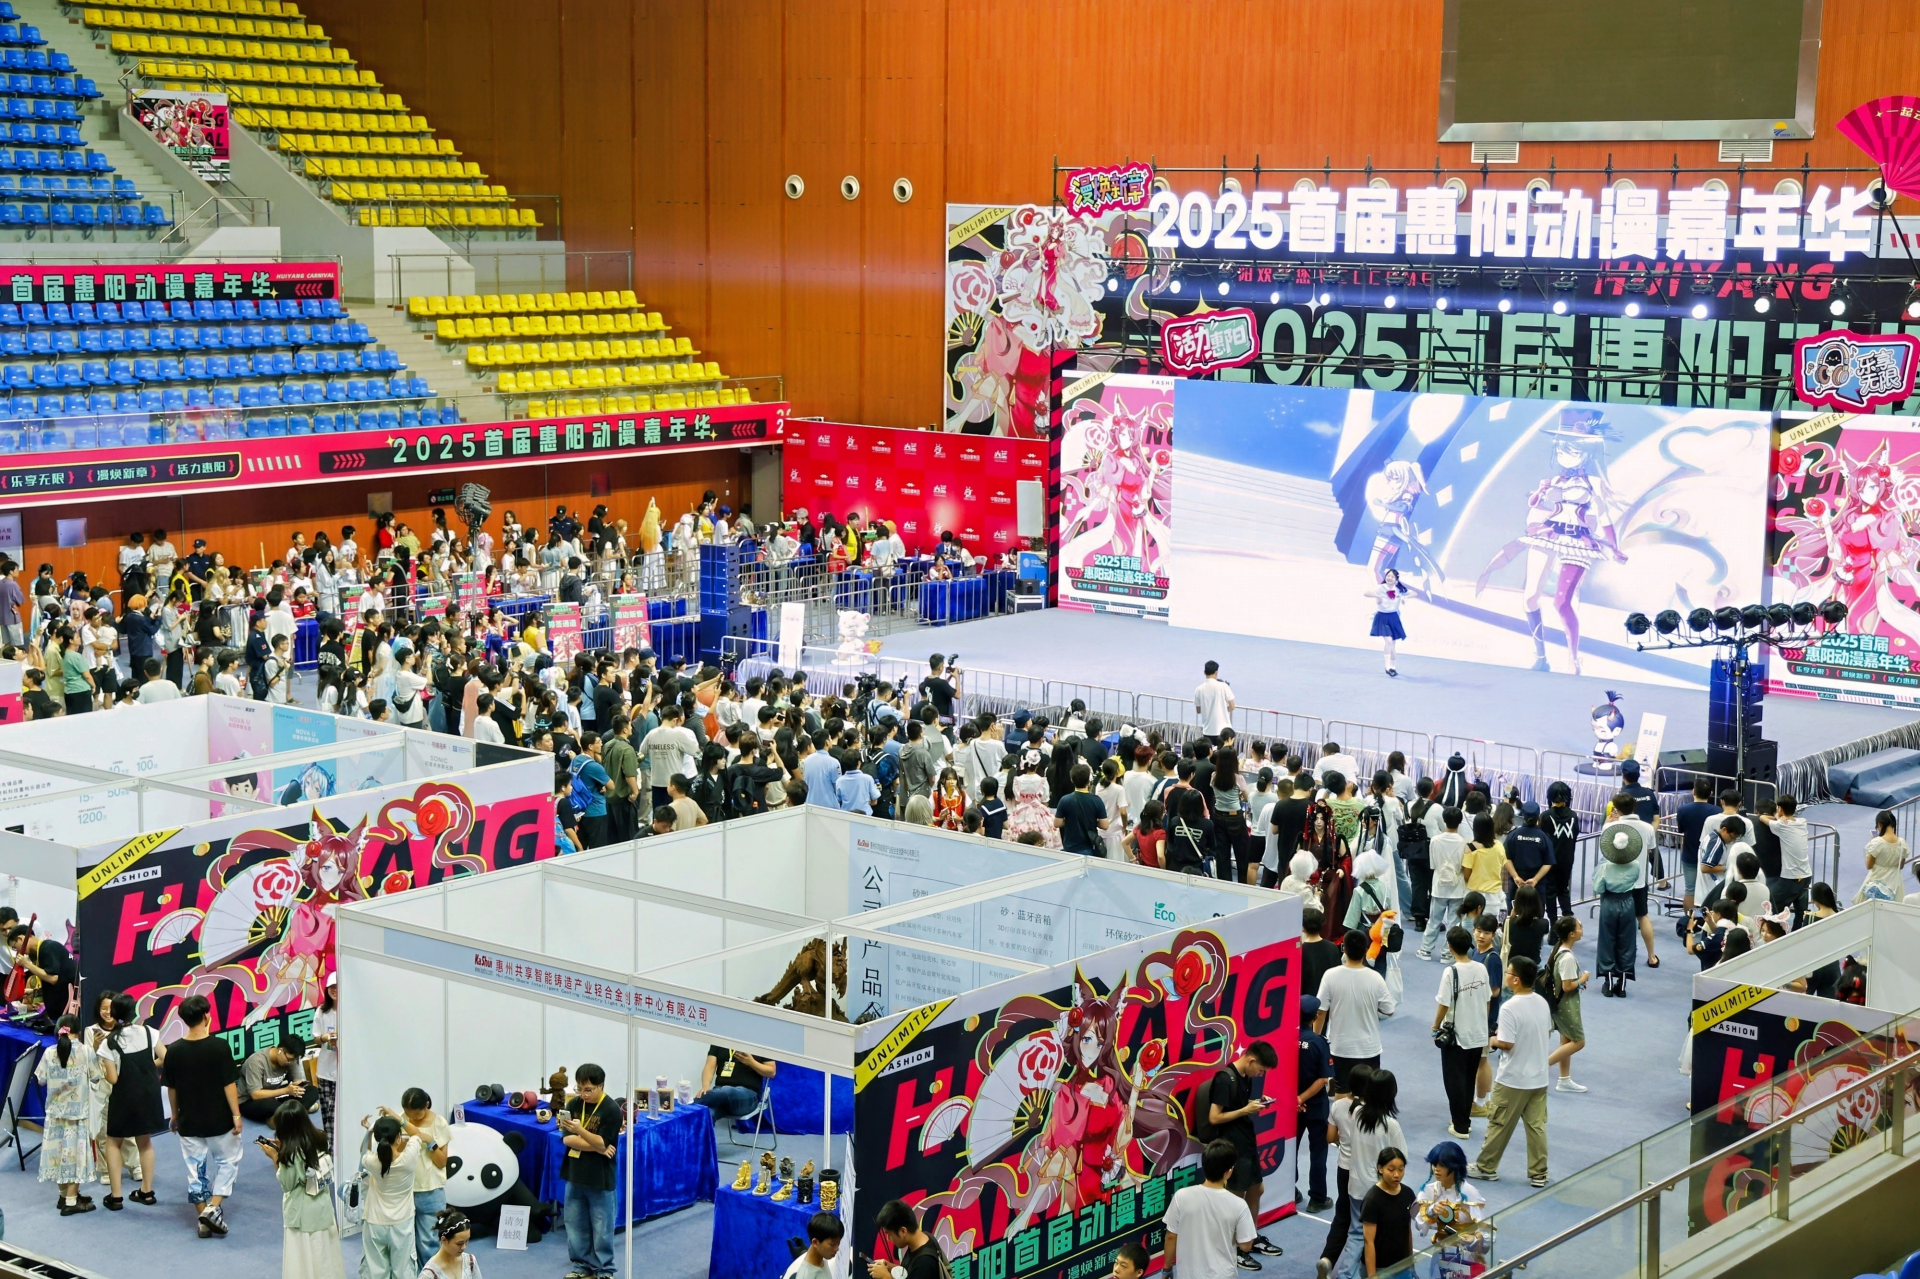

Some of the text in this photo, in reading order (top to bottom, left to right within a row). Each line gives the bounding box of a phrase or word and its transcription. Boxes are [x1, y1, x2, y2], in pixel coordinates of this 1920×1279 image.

[1073, 169, 1147, 209] 漫焕新章
[957, 208, 1005, 238] UNLIMITED
[1148, 184, 1873, 264] 2025首届惠阳动漫嘉年华
[11, 271, 271, 301] 首届惠阳动漫嘉年华
[1173, 320, 1248, 365] 活力惠阳
[393, 413, 711, 464] 2025首届惠阳动漫嘉年华
[1790, 412, 1846, 441] UNLIMITED
[11, 473, 65, 488] 乐享无限
[97, 467, 148, 481] 漫焕新章
[177, 461, 226, 475] 活力惠阳
[1084, 566, 1156, 586] 惠阳动漫嘉年华
[1094, 555, 1141, 570] 2025首届
[1806, 646, 1910, 671] 惠阳动漫嘉年华
[91, 831, 165, 884] UNLIMITED
[105, 867, 160, 886] FASHION
[496, 959, 708, 1022] 惠州共享智能铸造产业轻合金创新中心有限公司
[1702, 986, 1763, 1022] UNLIMITED
[867, 1003, 938, 1071] UNLIMITED
